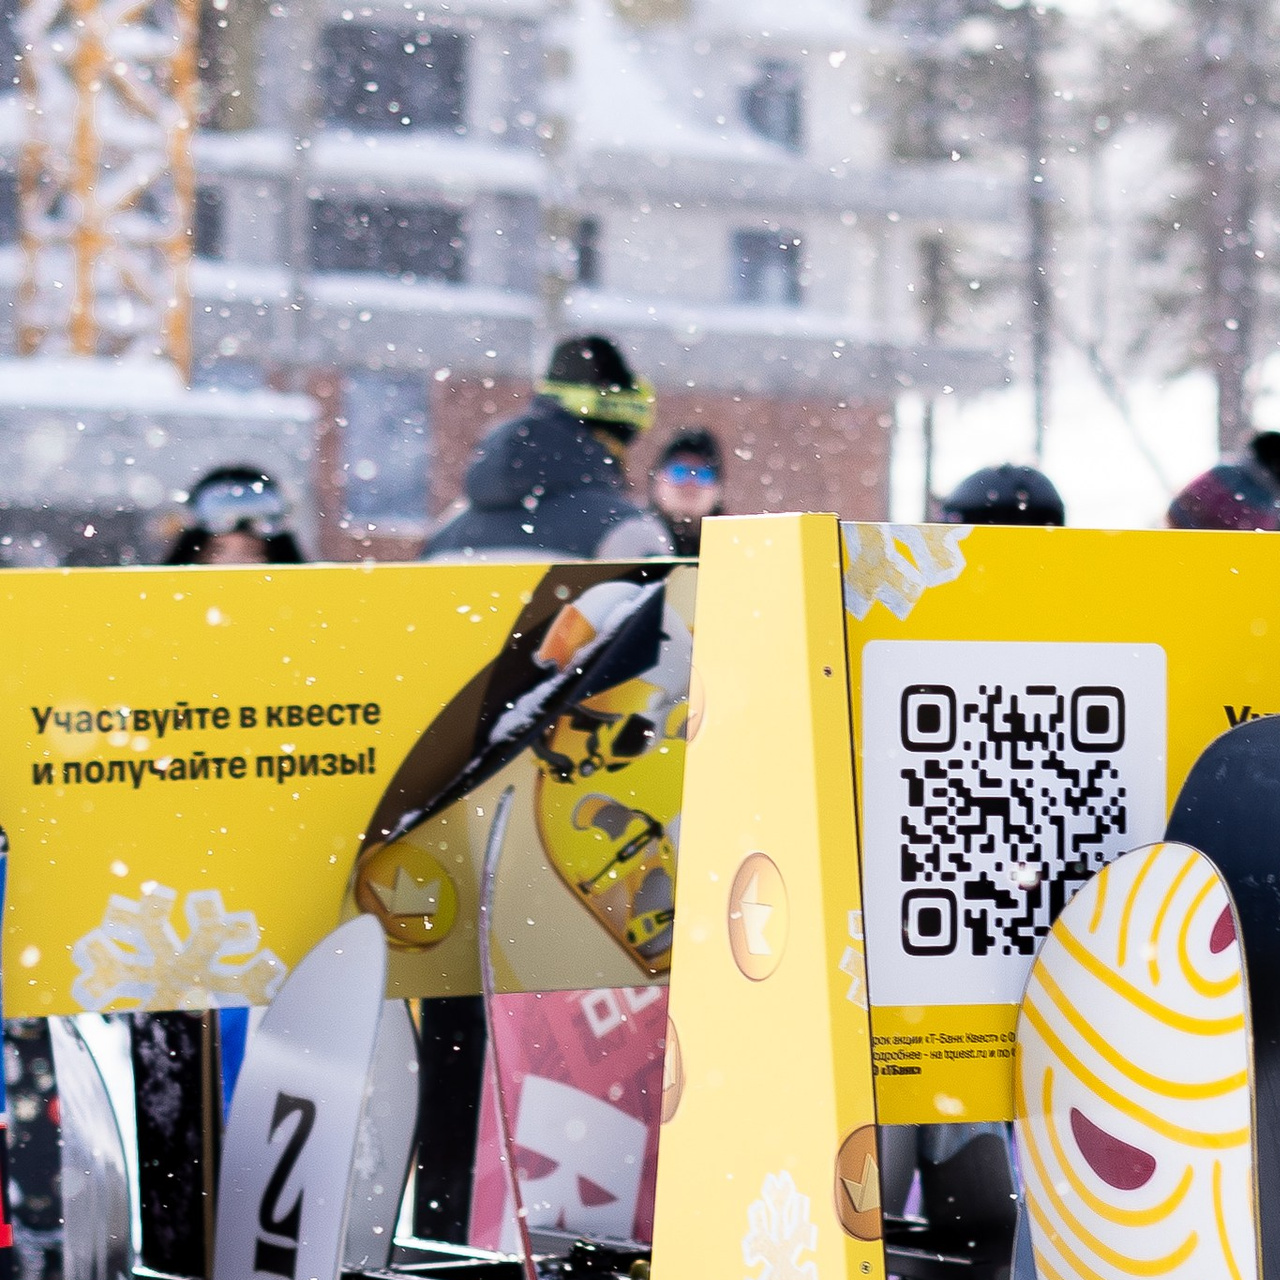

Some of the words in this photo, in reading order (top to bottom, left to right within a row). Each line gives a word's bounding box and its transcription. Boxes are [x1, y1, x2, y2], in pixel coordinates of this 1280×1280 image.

[31, 701, 231, 738] Участвуйте
[240, 705, 257, 729] в
[266, 702, 382, 729] квесте
[32, 761, 53, 785] и
[63, 751, 247, 789] получайте
[256, 747, 377, 784] призы!
